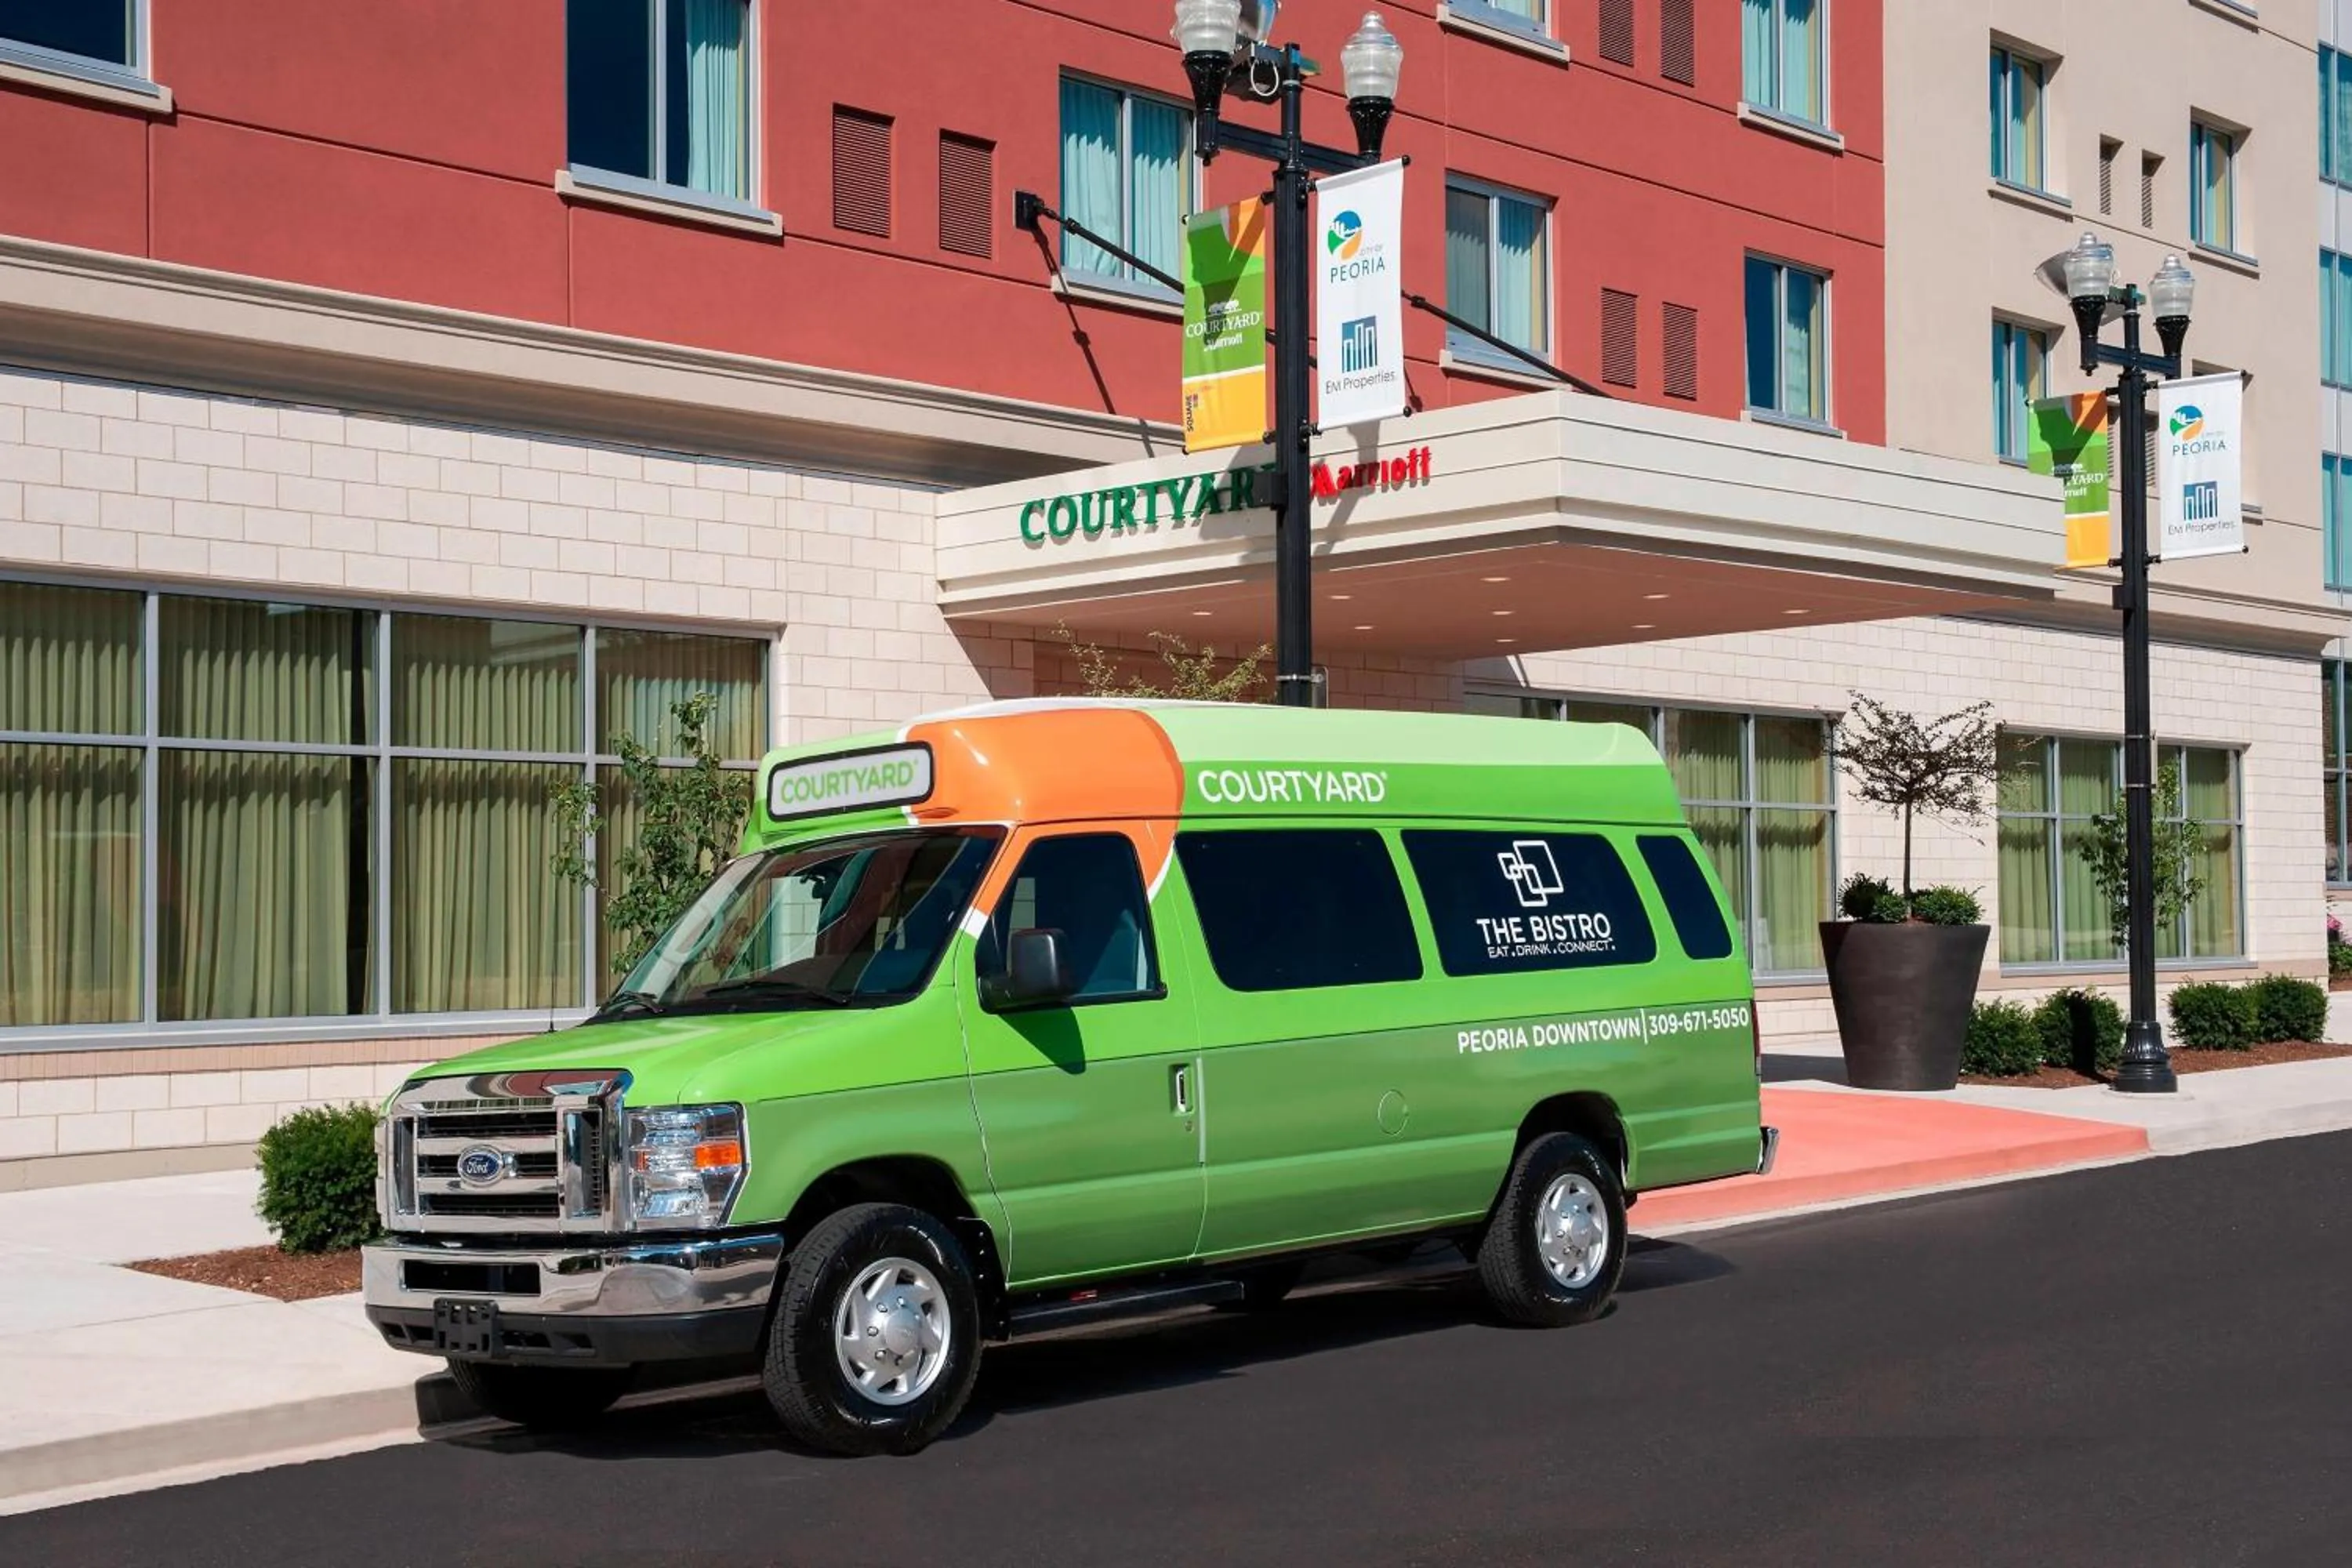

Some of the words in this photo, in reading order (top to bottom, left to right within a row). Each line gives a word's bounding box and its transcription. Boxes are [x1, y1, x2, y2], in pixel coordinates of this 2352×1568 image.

[1330, 256, 1385, 284] PEORIA
[1185, 311, 1260, 337] COURTYARD
[1326, 379, 1341, 394] EM
[1343, 370, 1396, 390] Properties
[2172, 440, 2227, 456] PEORIA
[1020, 463, 1278, 543] COURTYAR
[1310, 445, 1432, 498] Marriott
[781, 760, 914, 804] COURTYARD
[1198, 769, 1385, 803] COURTYARD
[1476, 916, 1526, 944] THE
[1530, 913, 1611, 942] BISTRO
[1457, 1027, 1528, 1054] PEORIA
[1533, 1017, 1641, 1047] DOWNTOWN
[1649, 1007, 1749, 1036] 309-671-5050
[466, 1156, 488, 1174] Ford
